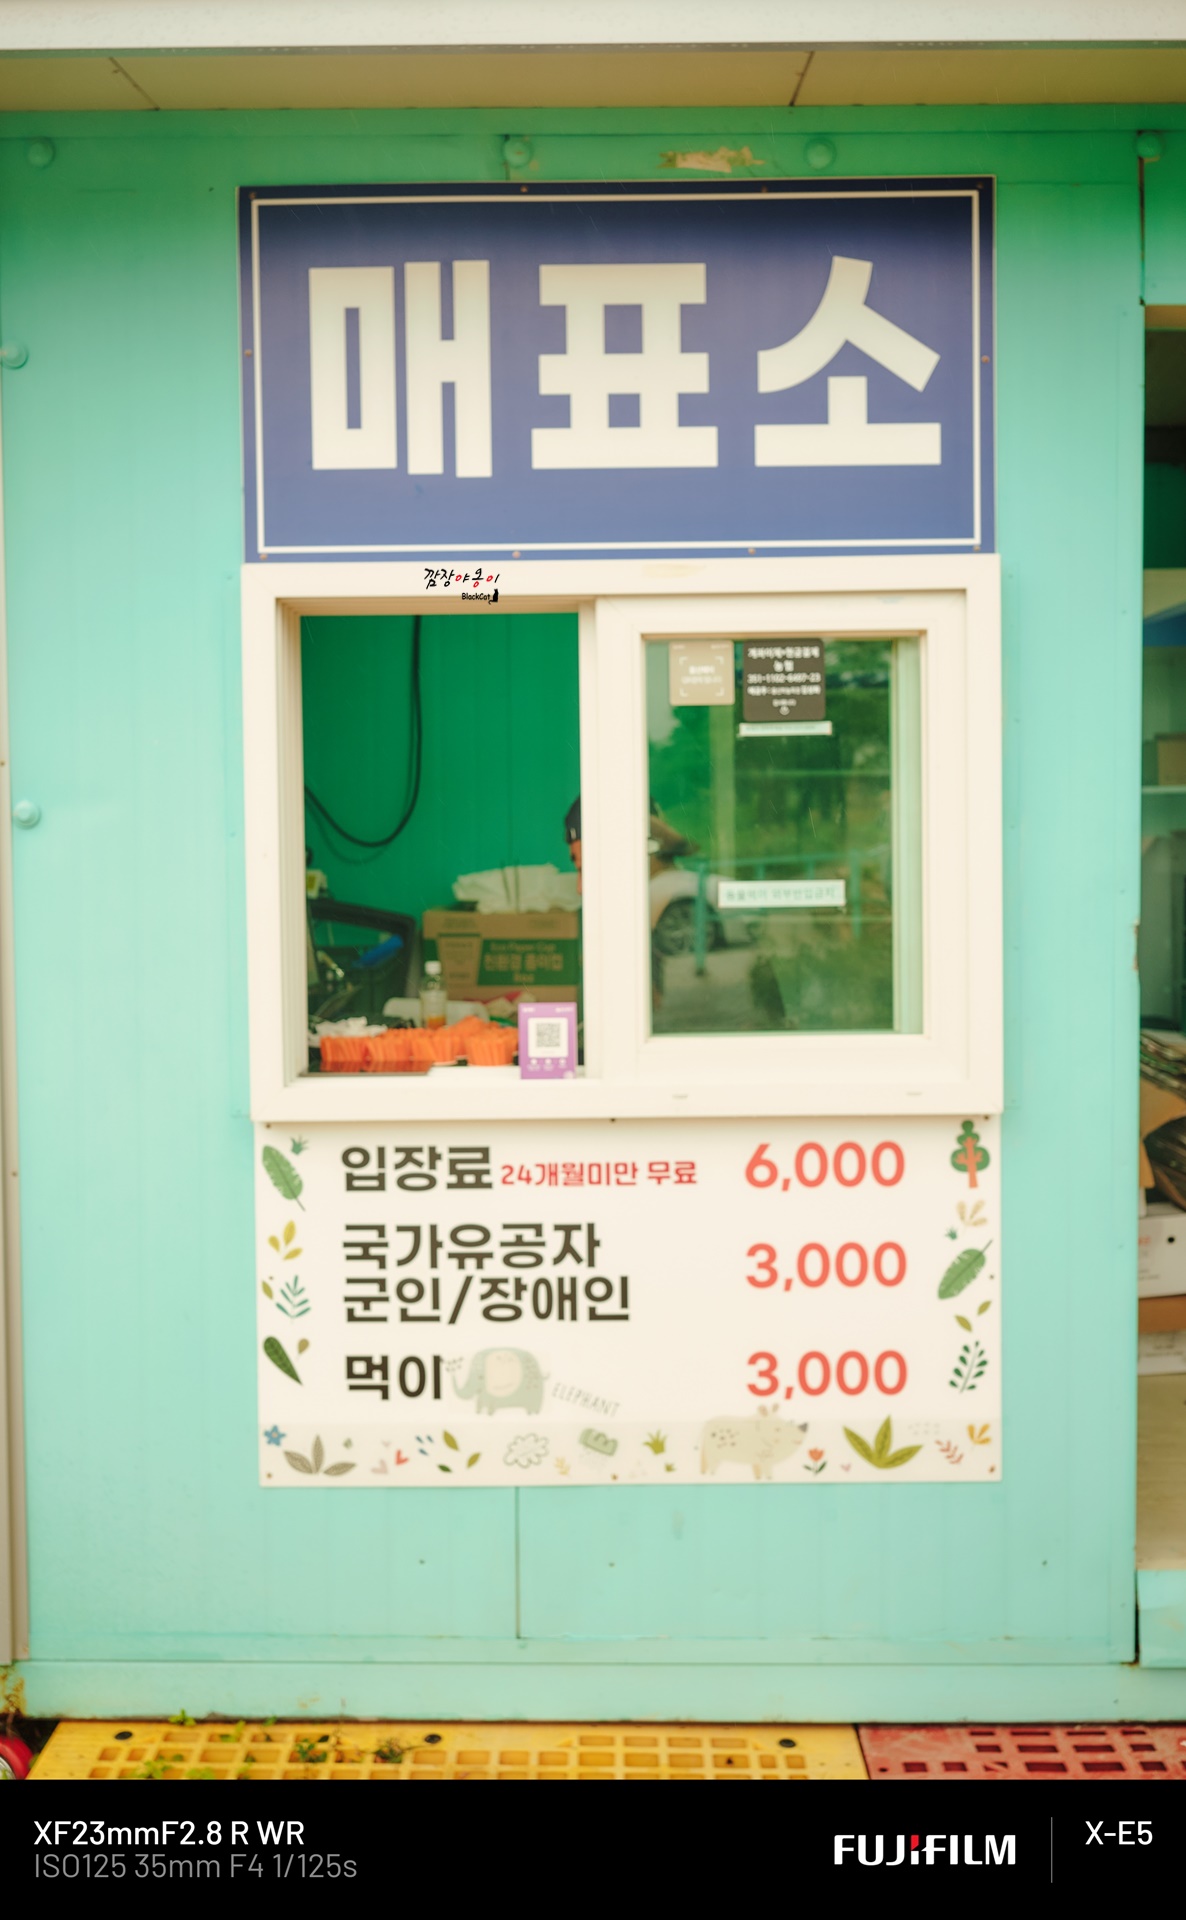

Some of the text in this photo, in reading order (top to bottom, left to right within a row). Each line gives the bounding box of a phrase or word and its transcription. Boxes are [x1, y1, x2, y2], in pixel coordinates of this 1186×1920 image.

[309, 255, 942, 479] 매표소
[341, 1140, 906, 1192] 입장료 24개월미만 무료 6,000
[342, 1222, 602, 1270] 국가유공자
[745, 1241, 908, 1292] 3,000
[343, 1275, 631, 1325] 군인/장애인
[345, 1349, 908, 1401] 먹이 3,000
[551, 1382, 620, 1418] ELEPHANT
